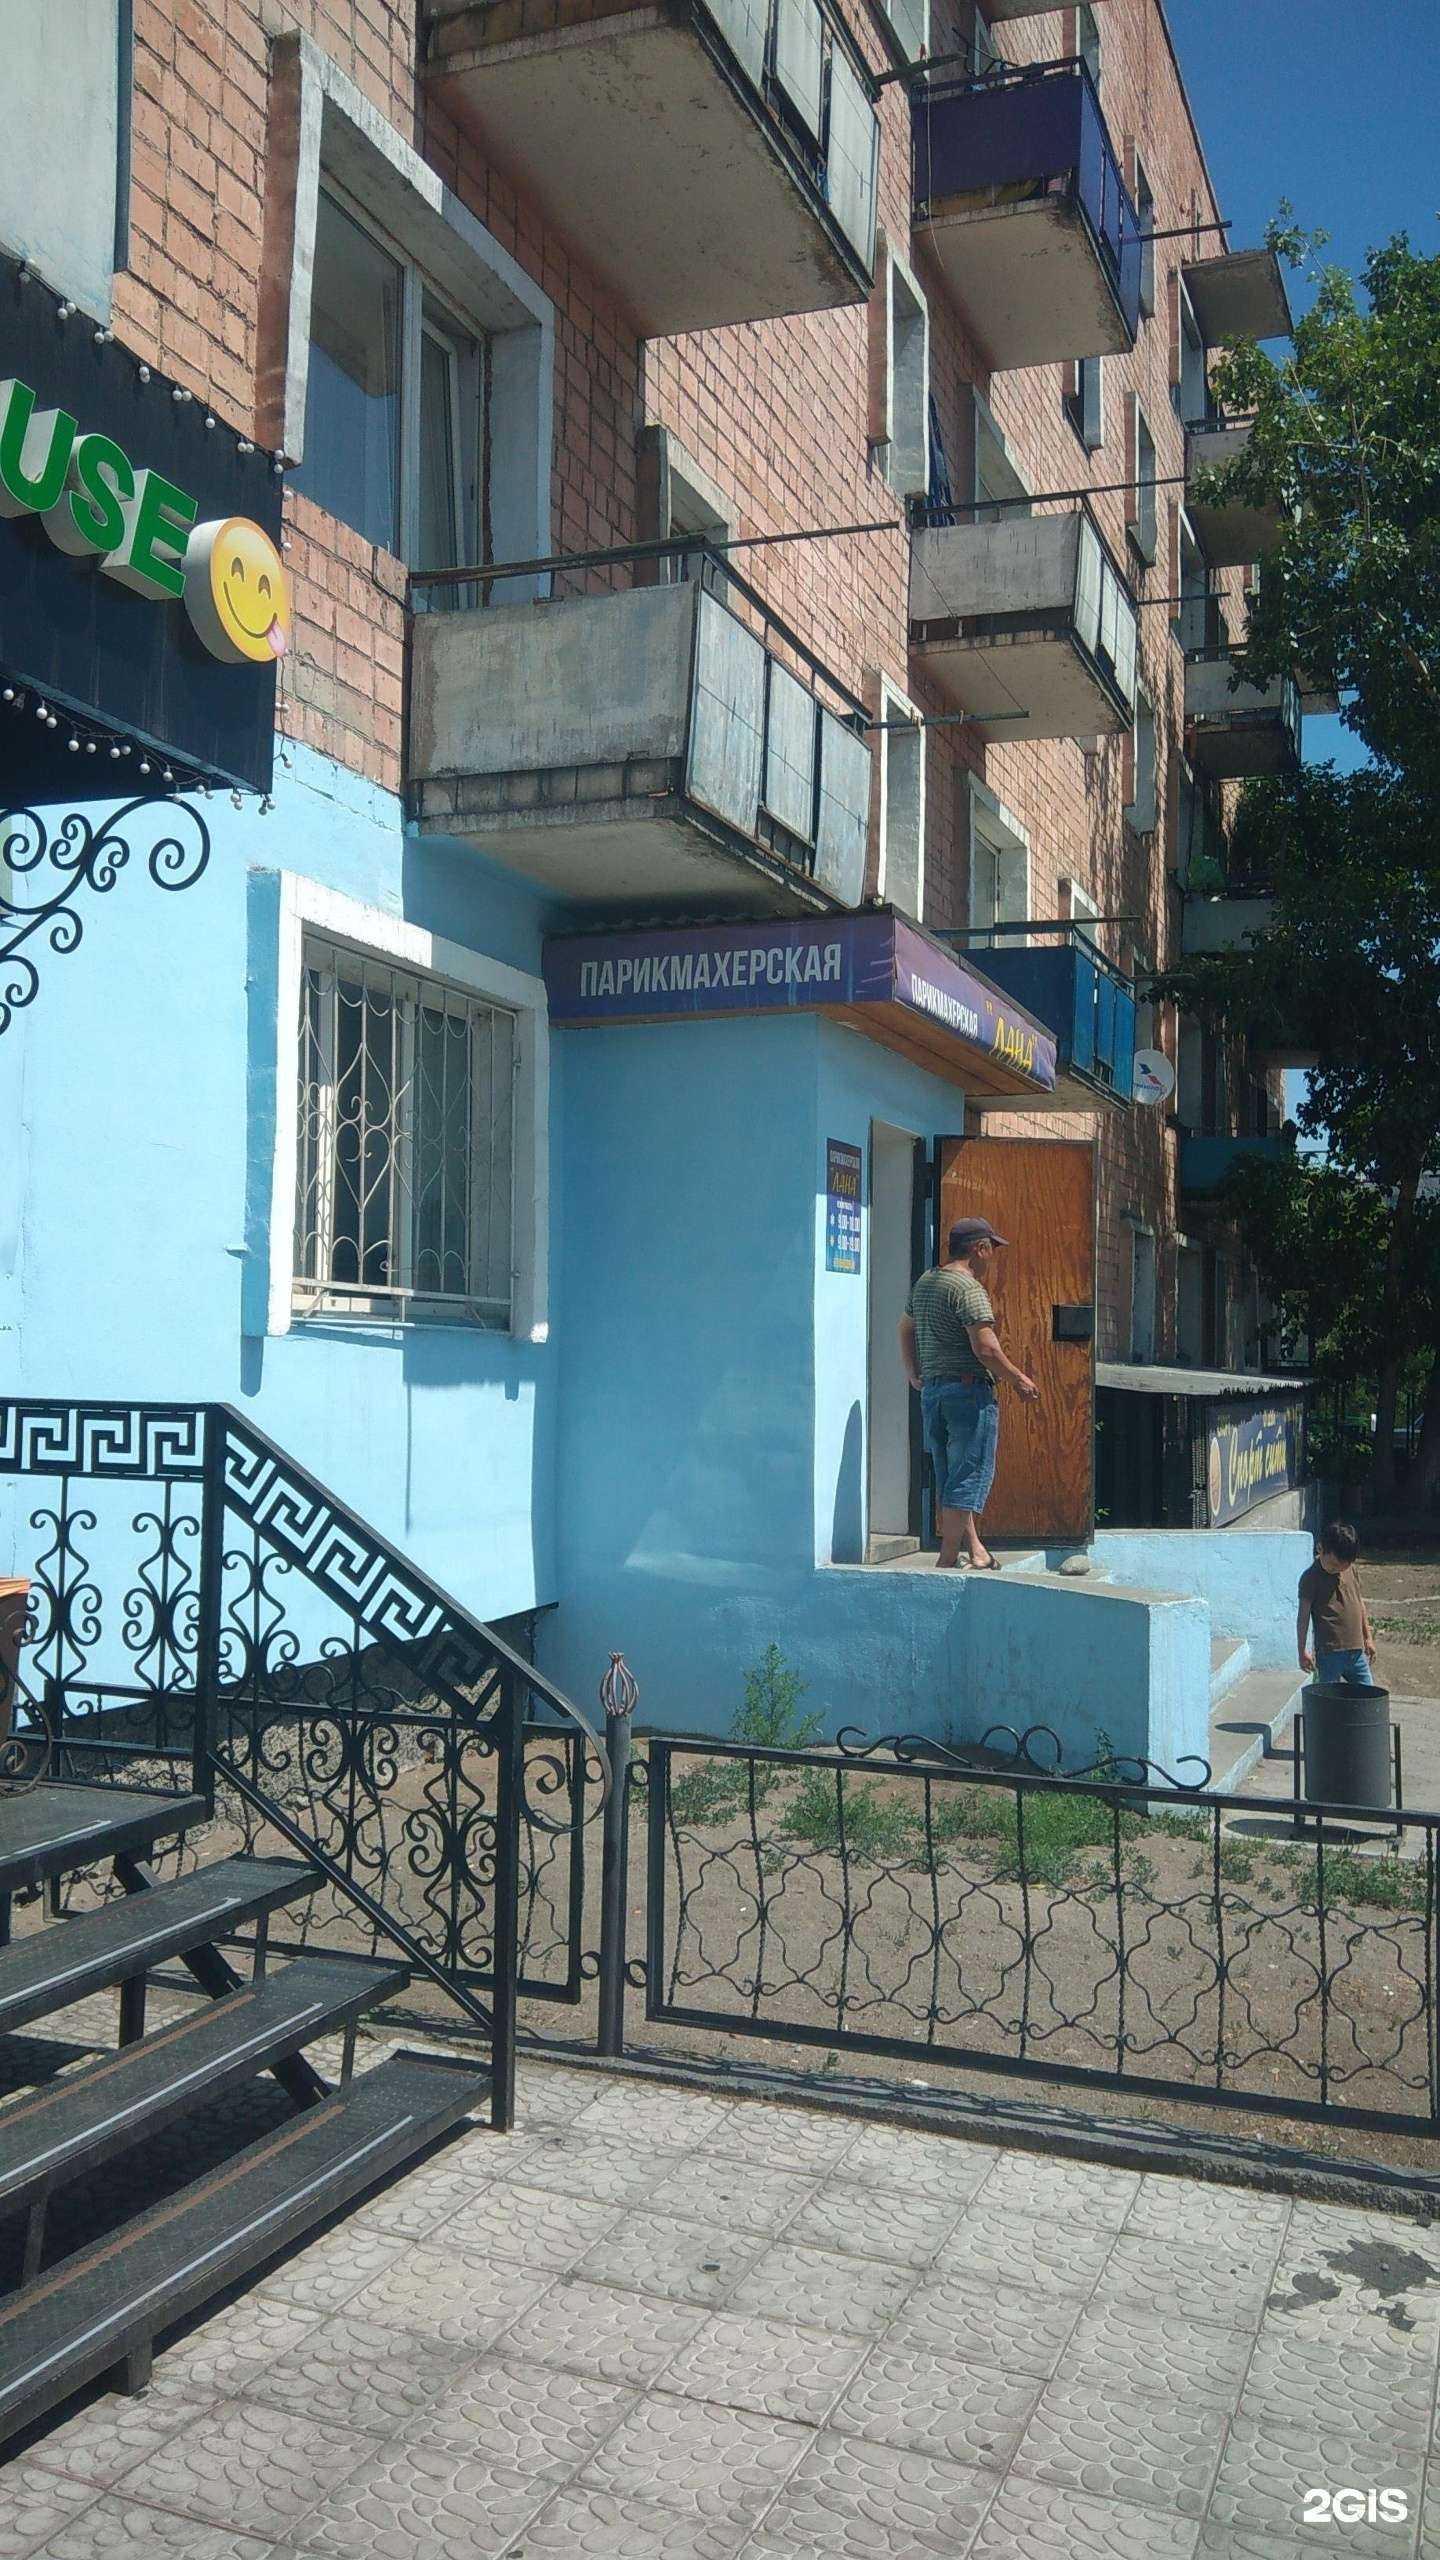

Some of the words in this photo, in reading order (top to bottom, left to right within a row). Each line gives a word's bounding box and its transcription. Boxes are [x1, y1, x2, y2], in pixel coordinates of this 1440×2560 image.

[0, 378, 199, 599] USE
[580, 943, 842, 997] ПАРИКМАХЕРСКАЯ
[911, 973, 979, 1041] ПАРИКМАХЕРСКАЯ
